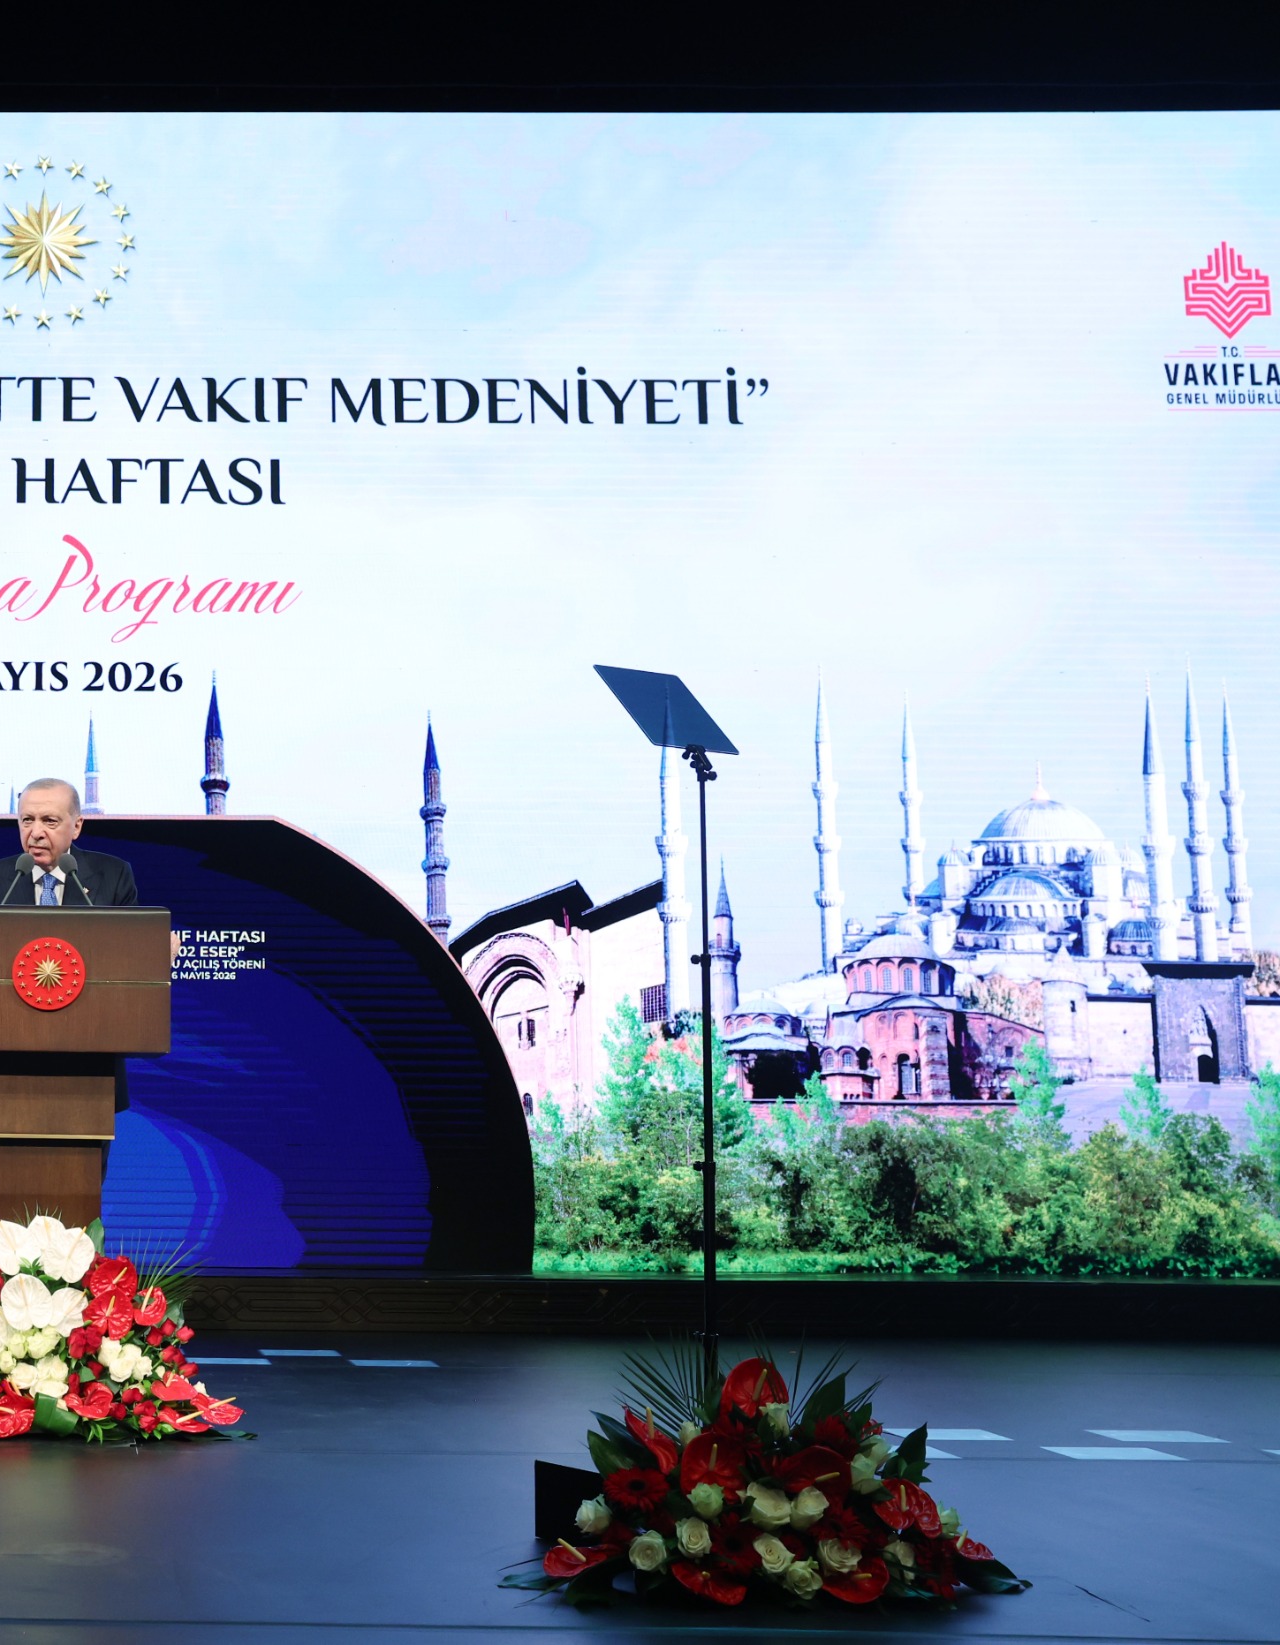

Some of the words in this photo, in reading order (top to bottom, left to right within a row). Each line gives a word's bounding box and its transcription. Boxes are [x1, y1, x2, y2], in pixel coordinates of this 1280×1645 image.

[1221, 346, 1242, 358] T.C.
[113, 376, 308, 424] VAKIF
[331, 366, 769, 427] MEDENİYETİ”
[1166, 392, 1209, 405] GENEL
[11, 457, 286, 506] HAFTASI
[24, 533, 304, 643] Programı
[82, 661, 183, 693] 2026
[171, 930, 192, 943] IF
[199, 945, 245, 958] ESER”
[182, 959, 220, 972] AÇILIŞ
[222, 957, 266, 970] TÖRENİ
[171, 971, 179, 980] 6
[180, 971, 211, 980] MAYIS
[212, 971, 236, 980] 2026
